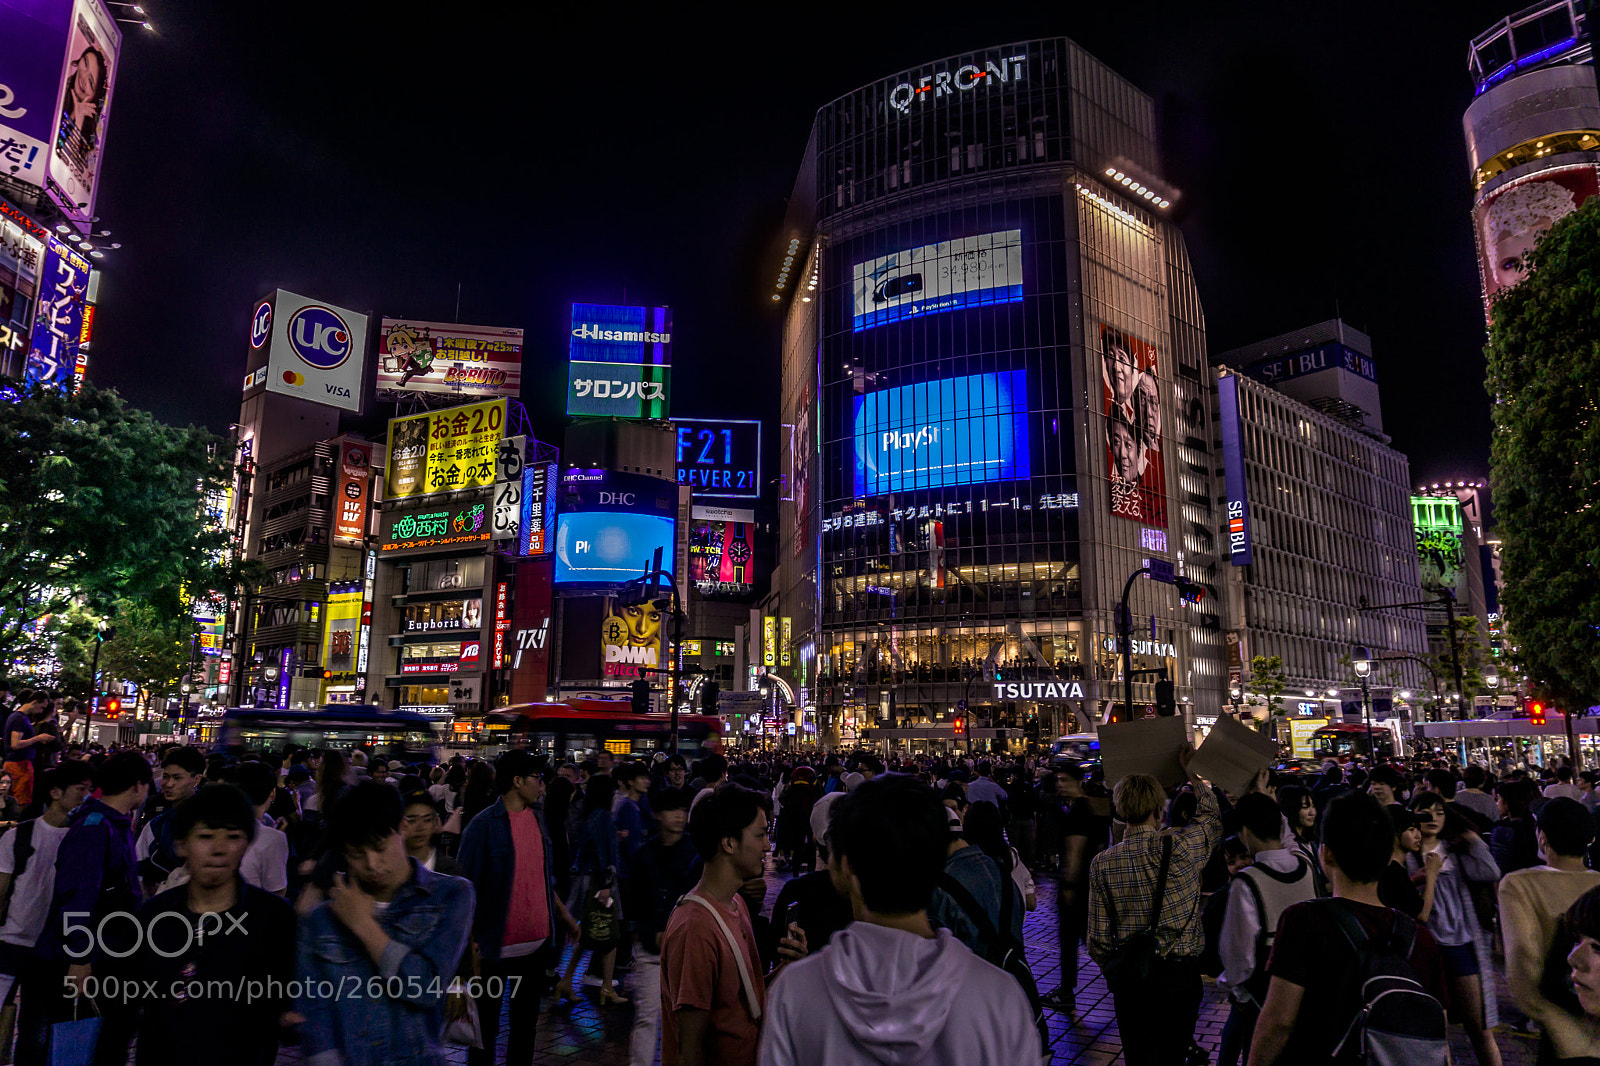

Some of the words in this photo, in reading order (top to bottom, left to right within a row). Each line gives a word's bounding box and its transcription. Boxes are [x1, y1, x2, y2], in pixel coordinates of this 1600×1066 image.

[890, 55, 1026, 115] QFRONT
[572, 324, 671, 343] Hisamitsu
[436, 349, 488, 363] お引越し!
[1262, 350, 1326, 381] SEIBU
[1344, 350, 1375, 380] SEIBU
[325, 383, 351, 399] VISA
[573, 378, 665, 400] サロンパス
[431, 405, 503, 440] お金2.0
[392, 445, 426, 461] お金2.0
[676, 427, 732, 464] F21
[494, 439, 523, 536] もんじゃ
[529, 468, 545, 550] 三千里薬品
[598, 491, 635, 506] DHC
[417, 518, 448, 537] 西村
[1228, 500, 1246, 554] SEIBU
[408, 618, 460, 632] Euphoria
[461, 644, 480, 659] JTB
[605, 644, 657, 665] DMM
[993, 682, 1084, 699] TSUTAYA
